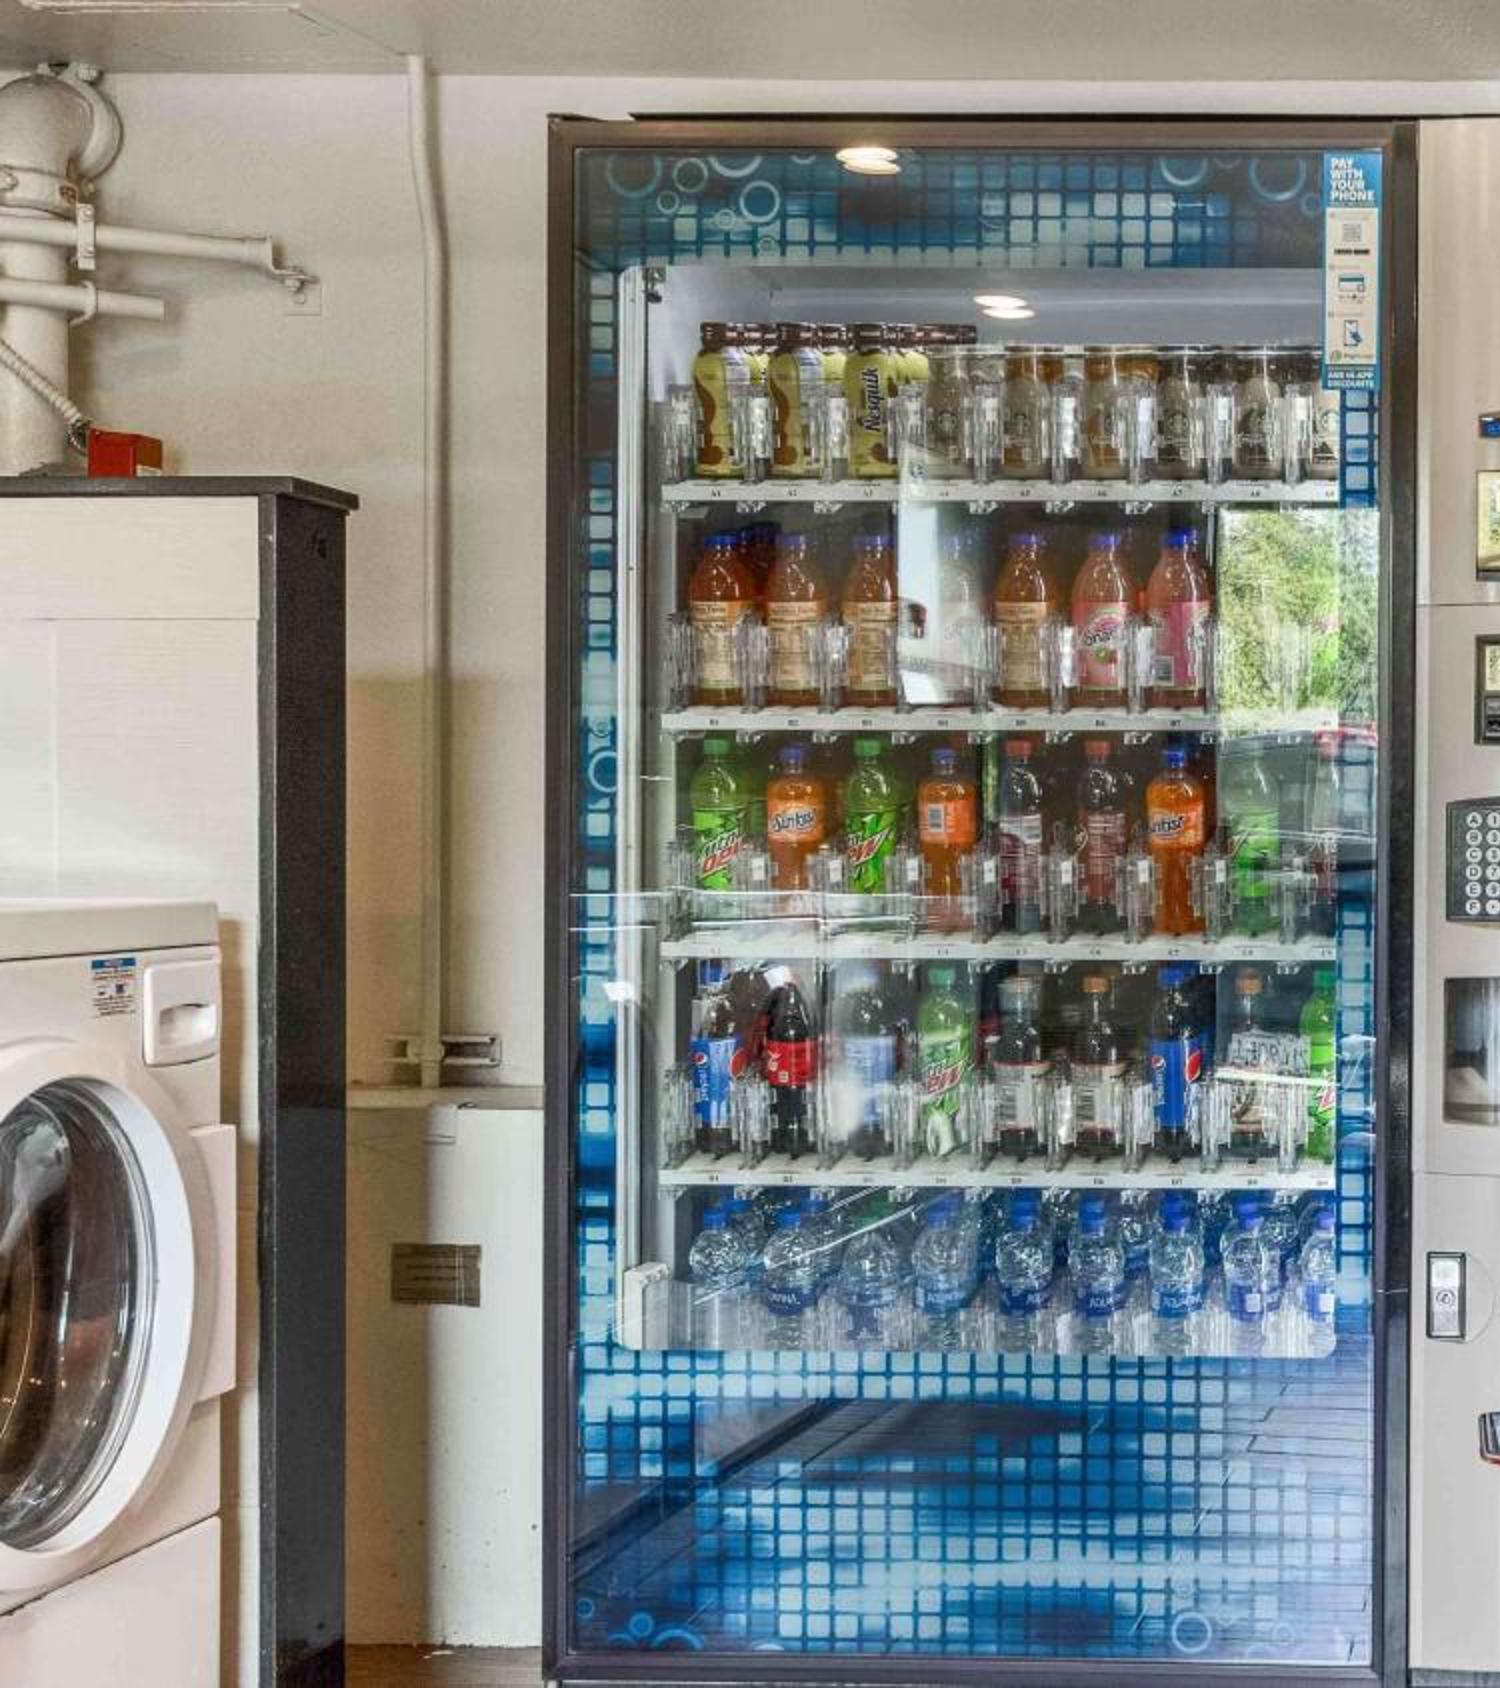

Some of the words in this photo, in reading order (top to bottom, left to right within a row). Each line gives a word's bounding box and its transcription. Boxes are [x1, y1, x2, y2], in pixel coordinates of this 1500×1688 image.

[1331, 158, 1354, 169] PAY
[1330, 169, 1363, 180] WITH
[1330, 180, 1365, 190] YOUR
[1330, 190, 1375, 201] PHONE
[863, 366, 881, 433] Nesquik
